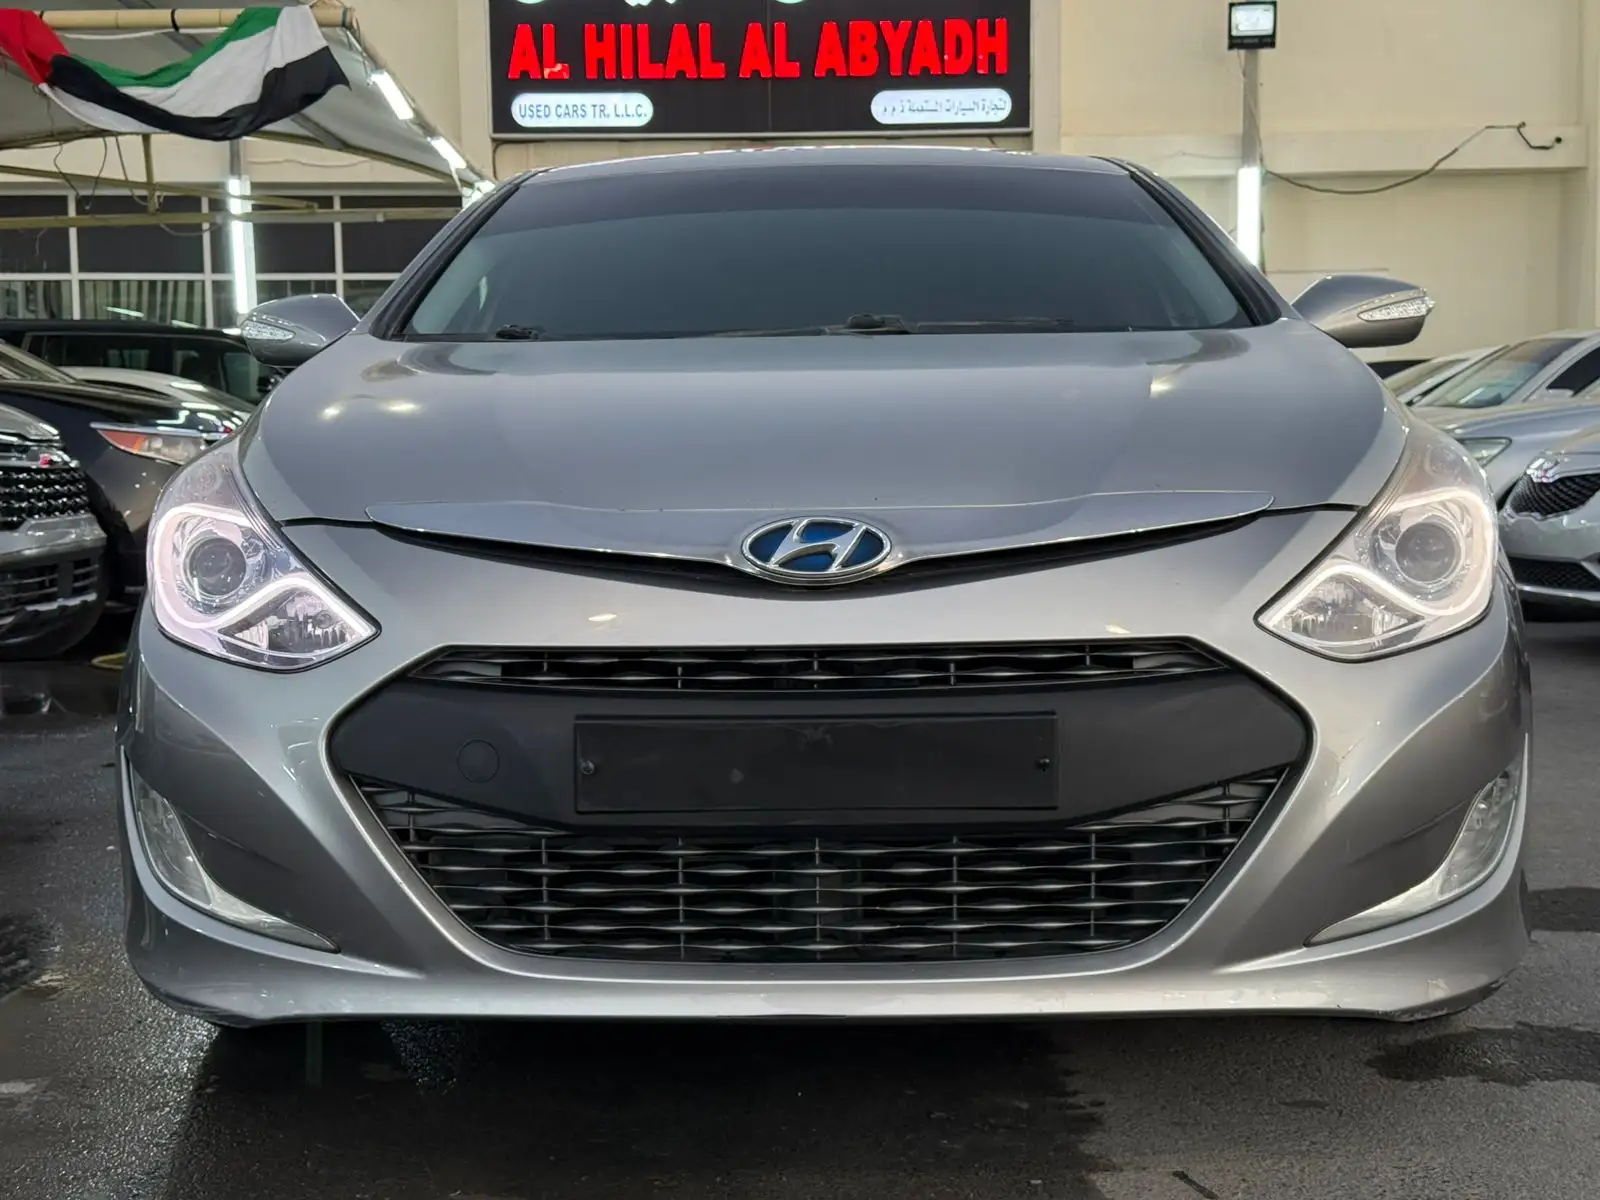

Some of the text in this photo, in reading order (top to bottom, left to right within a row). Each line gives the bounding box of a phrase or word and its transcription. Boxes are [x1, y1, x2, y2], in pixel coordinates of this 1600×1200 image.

[507, 18, 1008, 80] AL HILAL AL ABYADH
[519, 103, 648, 118] USED CARS TR. L.L.C.
